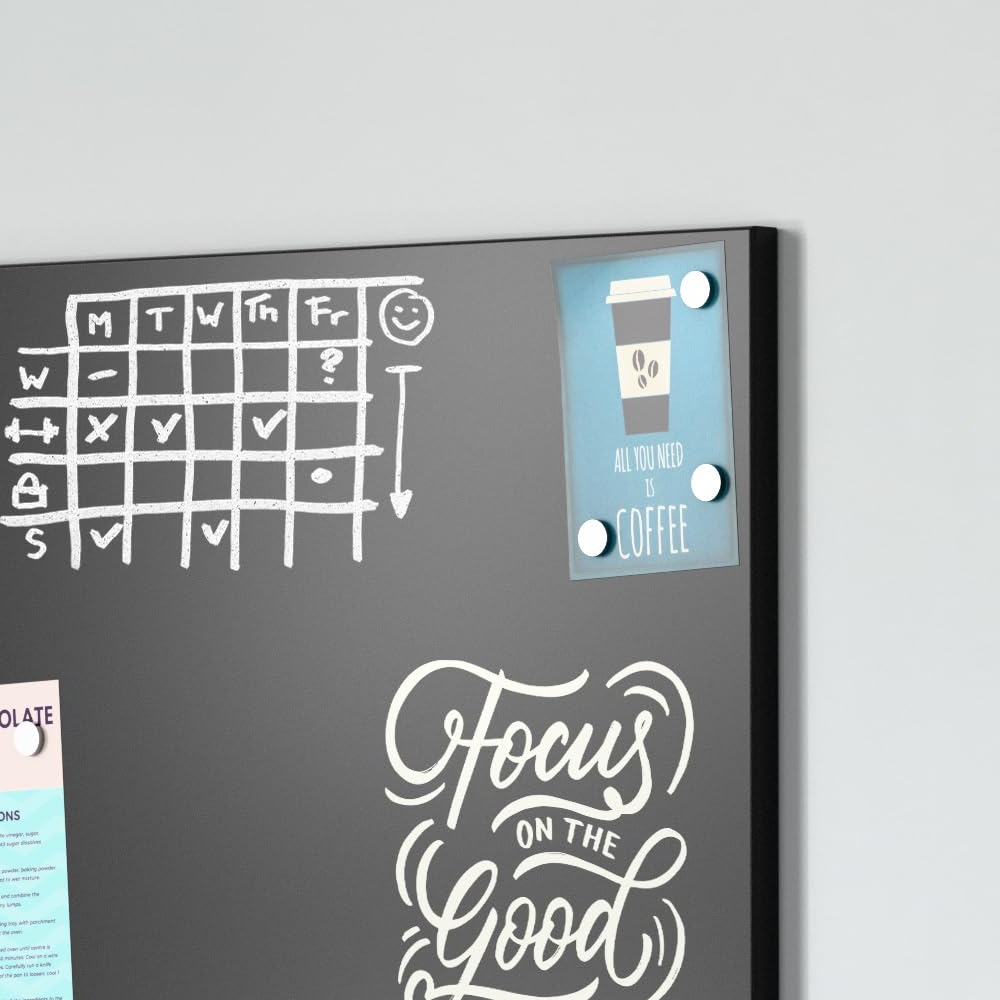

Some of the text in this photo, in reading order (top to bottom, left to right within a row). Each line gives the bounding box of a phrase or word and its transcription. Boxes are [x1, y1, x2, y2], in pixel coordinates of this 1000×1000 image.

[87, 310, 112, 338] M
[146, 307, 175, 331] T
[197, 302, 224, 327] W
[304, 296, 349, 326] Fr
[19, 366, 49, 390] W
[614, 441, 684, 473] ALL YOU NEED
[644, 477, 655, 498] IS
[25, 528, 47, 559] S
[616, 504, 690, 560] COFFEE
[385, 659, 653, 830] Focus
[517, 817, 621, 859] ON THE
